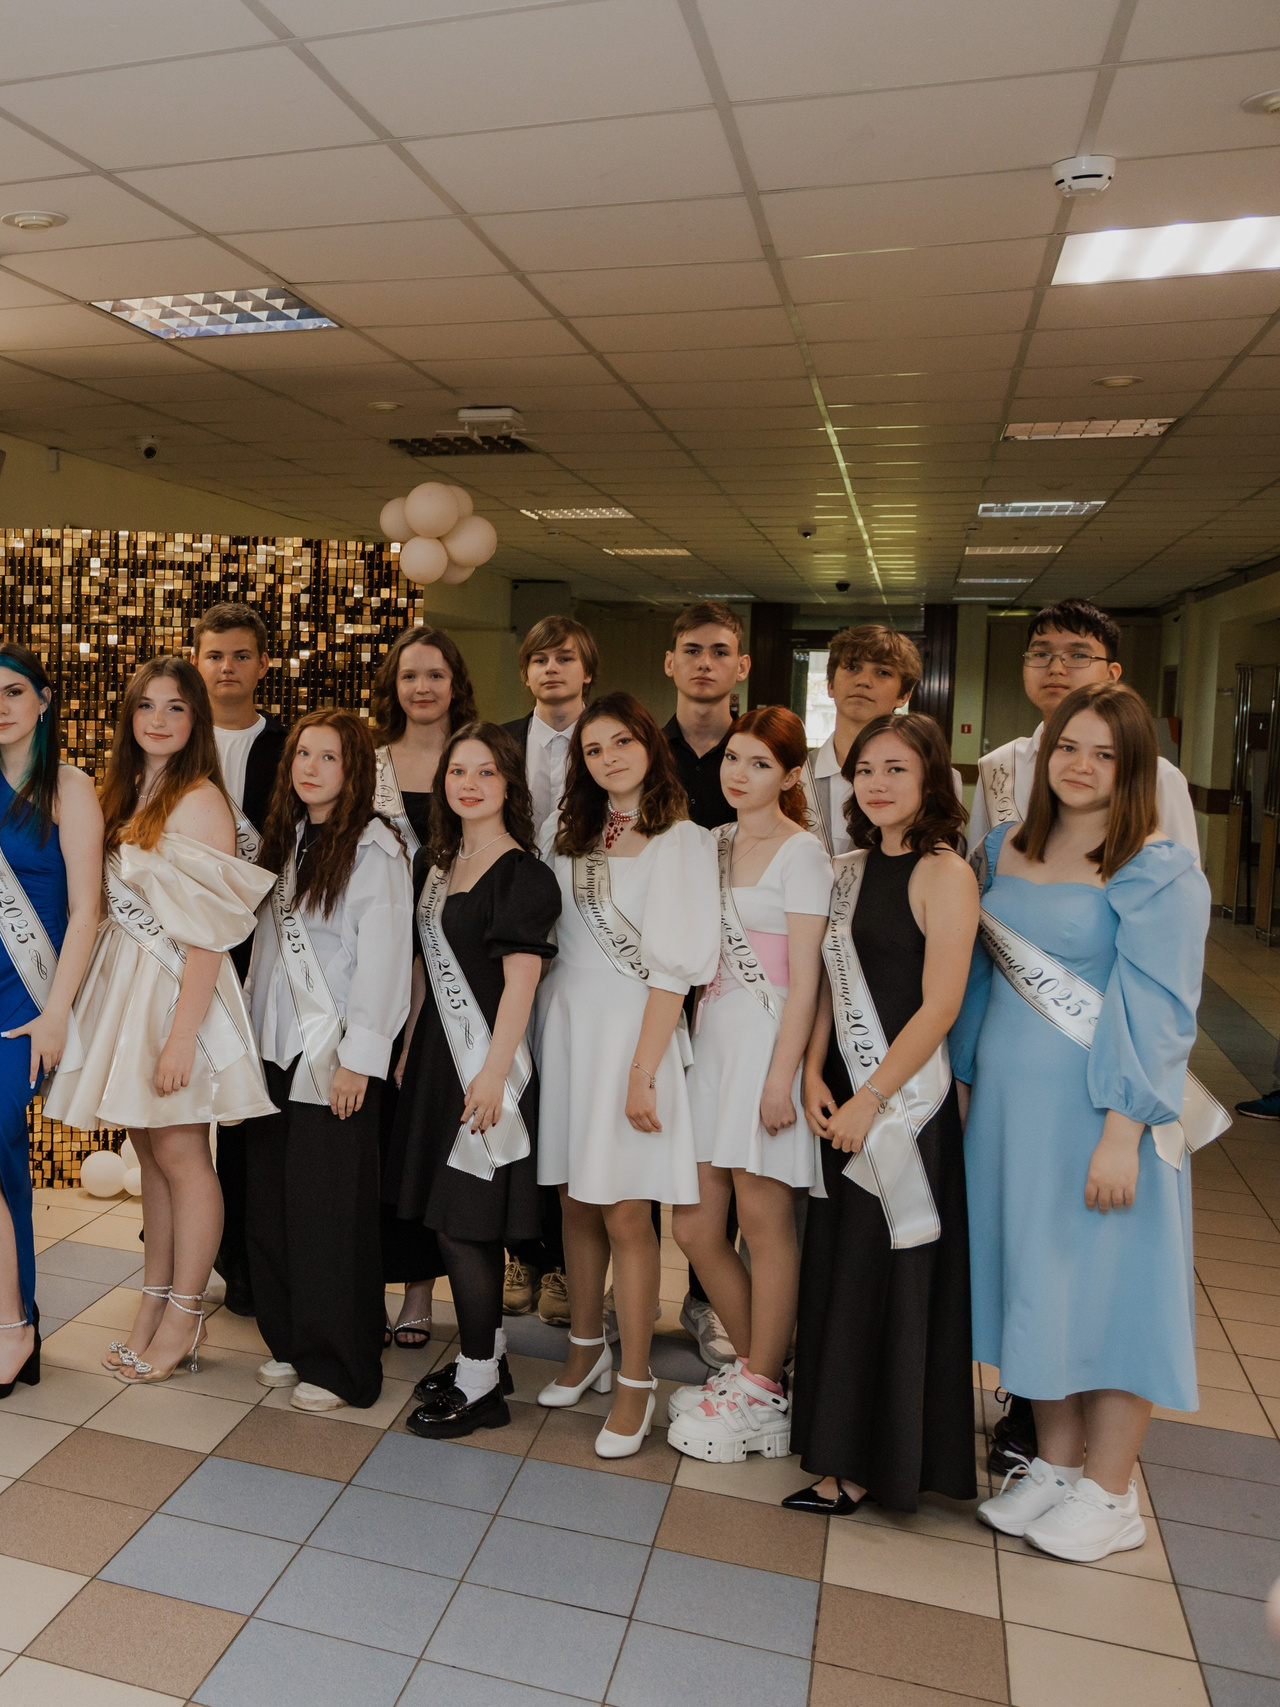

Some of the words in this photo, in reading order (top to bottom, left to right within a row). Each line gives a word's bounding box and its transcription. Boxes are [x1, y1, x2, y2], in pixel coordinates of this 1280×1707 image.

[578, 849, 613, 935] Выпускница
[116, 900, 164, 936] 2025
[279, 904, 306, 954] 2025
[422, 870, 447, 957] Выпускница
[437, 959, 468, 1010] 2025
[726, 932, 765, 983] 2025
[827, 901, 852, 1008] Выпускница
[845, 1009, 880, 1068] 2025
[1021, 967, 1091, 1017] 2025
